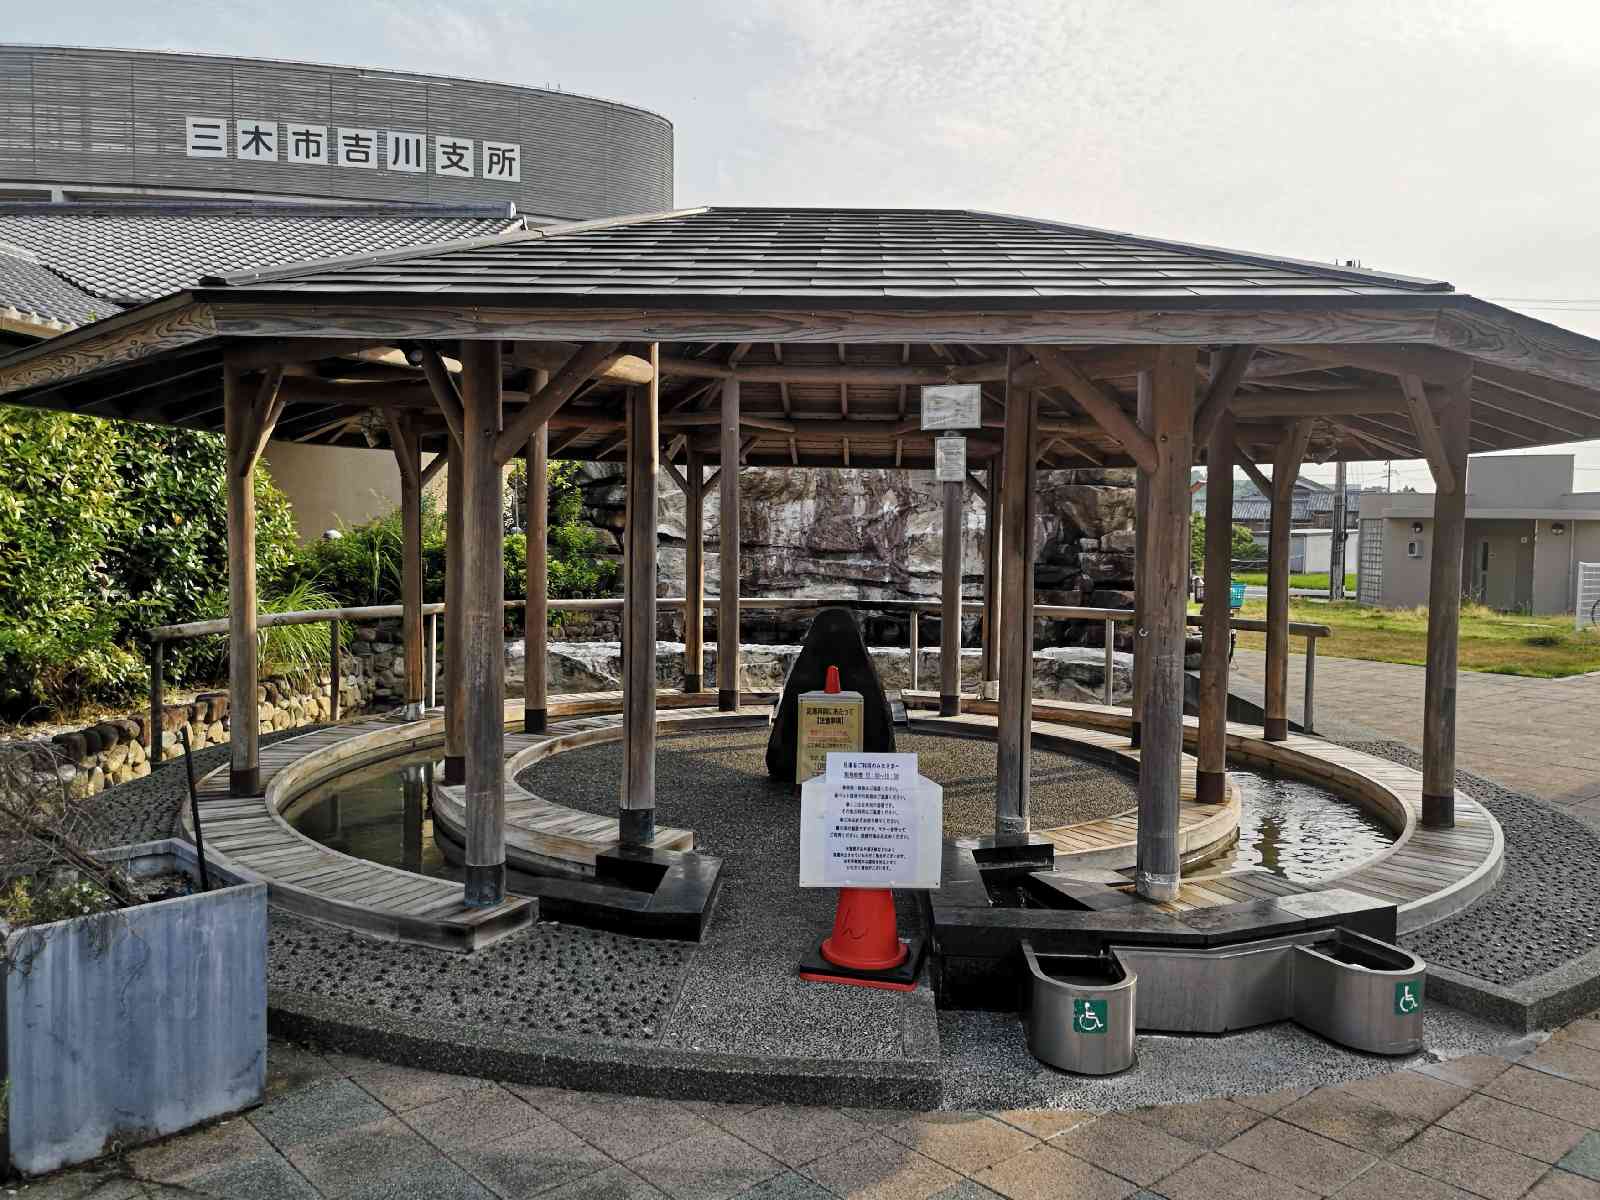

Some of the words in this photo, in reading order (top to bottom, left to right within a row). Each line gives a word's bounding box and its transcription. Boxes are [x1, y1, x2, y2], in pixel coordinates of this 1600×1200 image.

[192, 123, 516, 177] 三木市吉川支所
